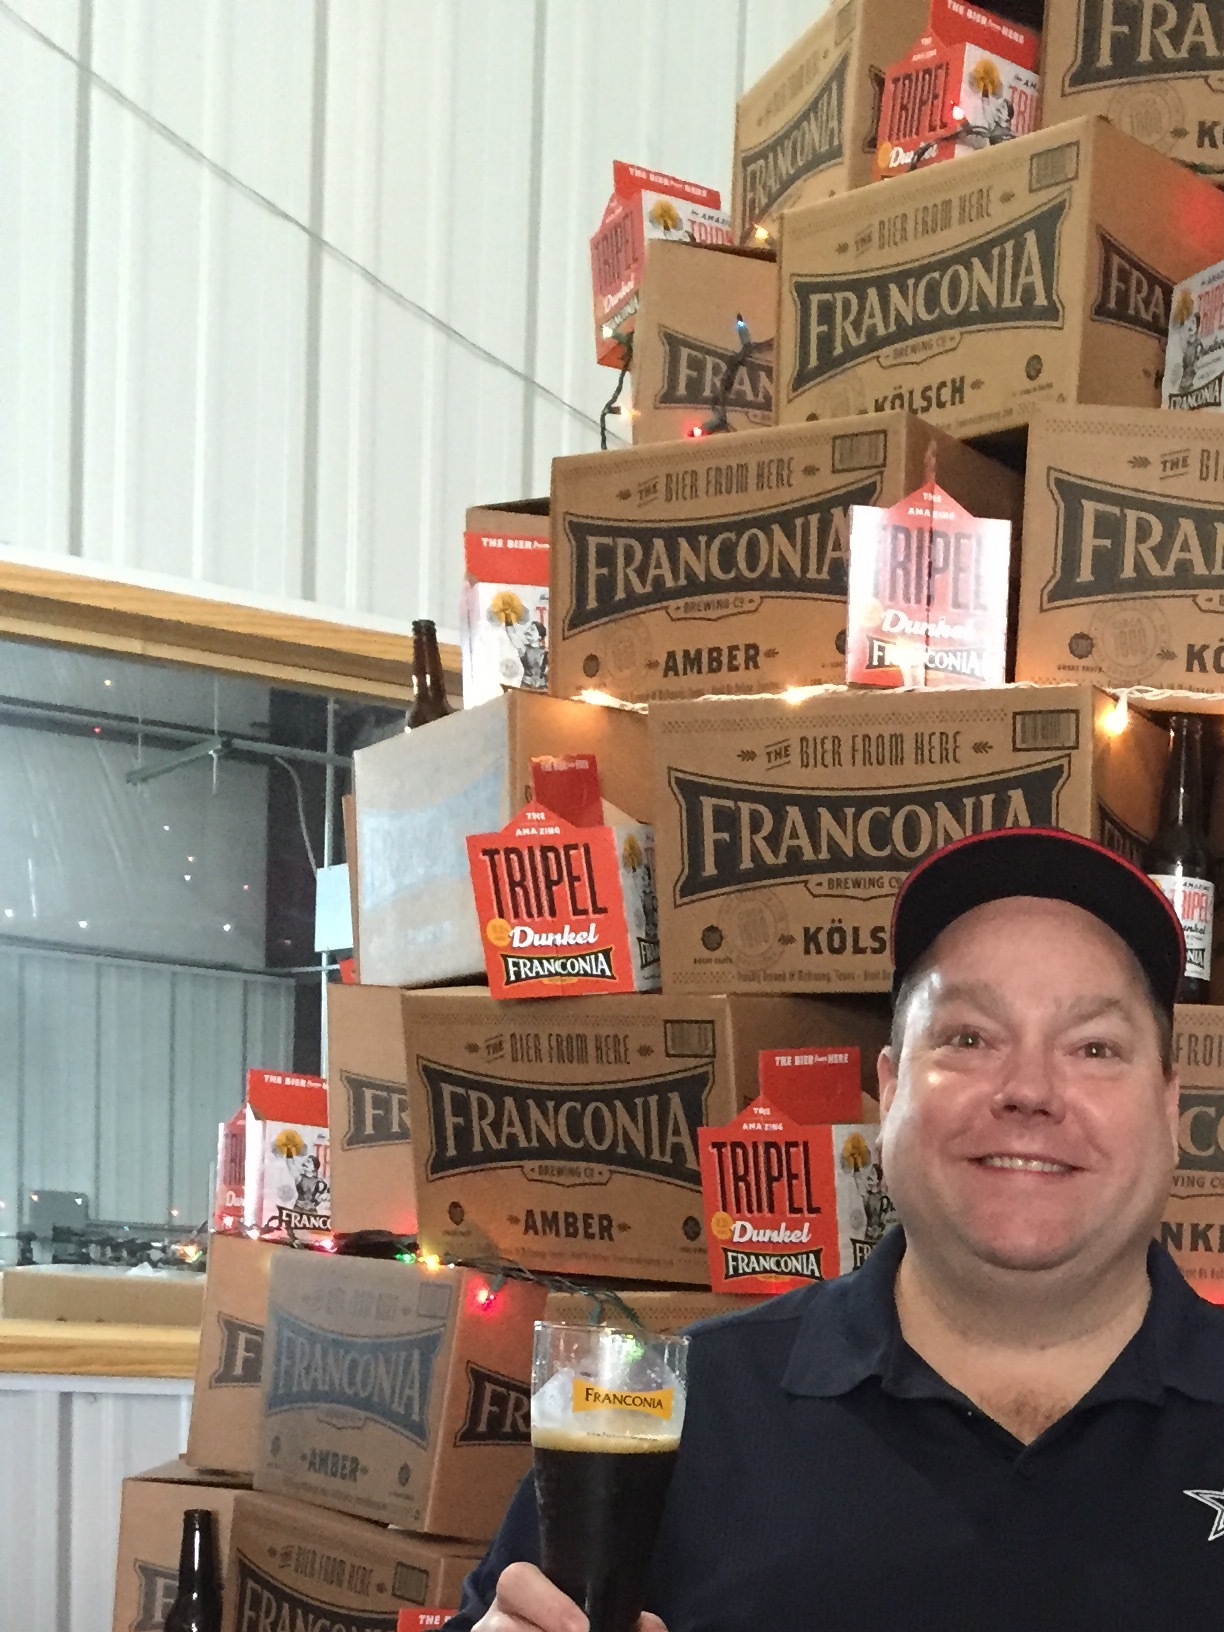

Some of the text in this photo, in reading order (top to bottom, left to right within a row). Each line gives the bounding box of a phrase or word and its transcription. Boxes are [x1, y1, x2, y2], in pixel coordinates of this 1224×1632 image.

[741, 75, 844, 228] FRANCONIA
[877, 184, 994, 250] BIER FROM HERE
[805, 226, 1050, 372] FRANCONIA
[664, 468, 701, 503] BIER
[705, 462, 749, 498] FROM
[754, 456, 796, 491] HERE
[1159, 454, 1191, 473] THE
[922, 492, 943, 503] THE
[583, 506, 849, 612] FRANCONIA
[872, 523, 989, 611] TRIPEL
[680, 598, 733, 616] BREWING
[661, 640, 763, 680] AMBER
[765, 730, 963, 770] THE BIER FROM HERE
[479, 842, 609, 924] TRIPEL
[826, 875, 886, 891] BREWING
[508, 922, 600, 950] Dunkel
[506, 952, 612, 981] FRANCONIA
[547, 1034, 591, 1065] FROM
[441, 1082, 700, 1172] FRANCONIA
[710, 1138, 822, 1218] TRIPEL
[522, 1208, 615, 1242] AMBER
[729, 1219, 813, 1248] Dunkel
[725, 1251, 821, 1280] FRANCONIA
[274, 1332, 425, 1424] FRANCONIA
[584, 1387, 664, 1410] FRANCONIA
[306, 1451, 362, 1484] AMBER
[417, 1613, 441, 1626] THE
